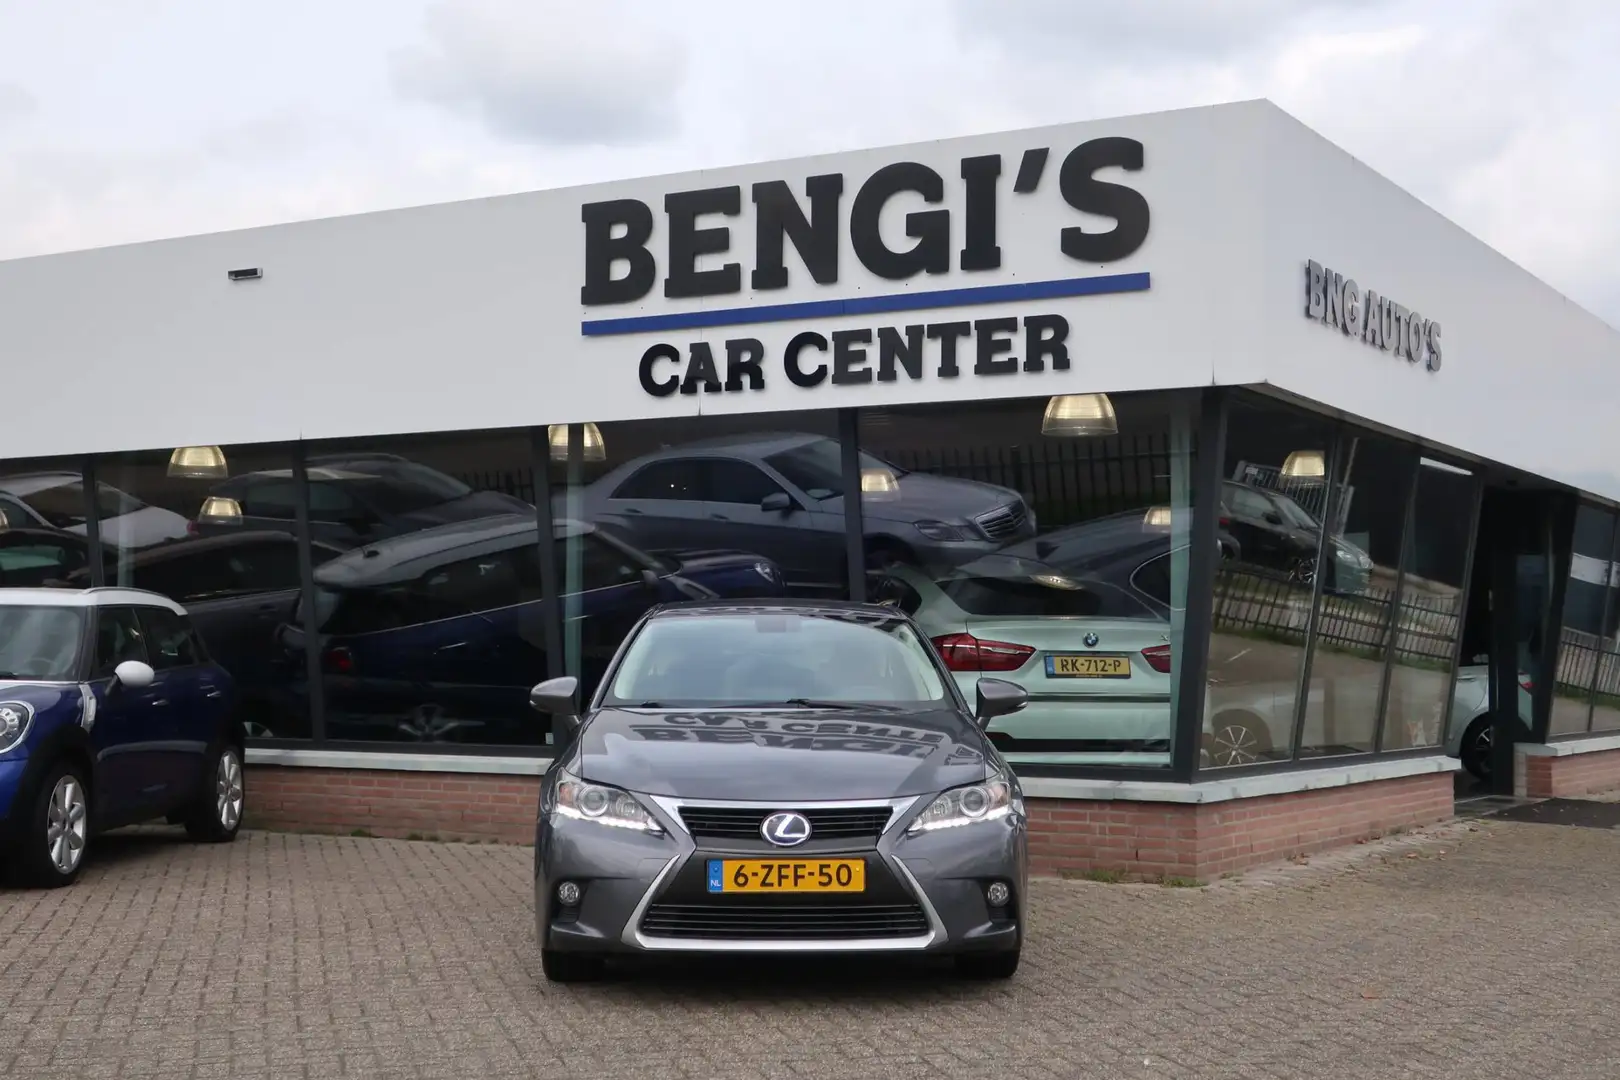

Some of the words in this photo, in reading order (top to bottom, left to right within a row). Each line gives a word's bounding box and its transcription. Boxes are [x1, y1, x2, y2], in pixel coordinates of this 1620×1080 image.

[581, 137, 1150, 306] BENGI'S
[639, 338, 765, 397] CAR
[784, 314, 1071, 388] CENTER
[1305, 259, 1359, 336] BNG
[1364, 290, 1442, 372] AUTO'S
[1060, 659, 1121, 672] RK-712-P
[710, 879, 721, 887] NL
[733, 863, 852, 888] 6-ZFF-50
